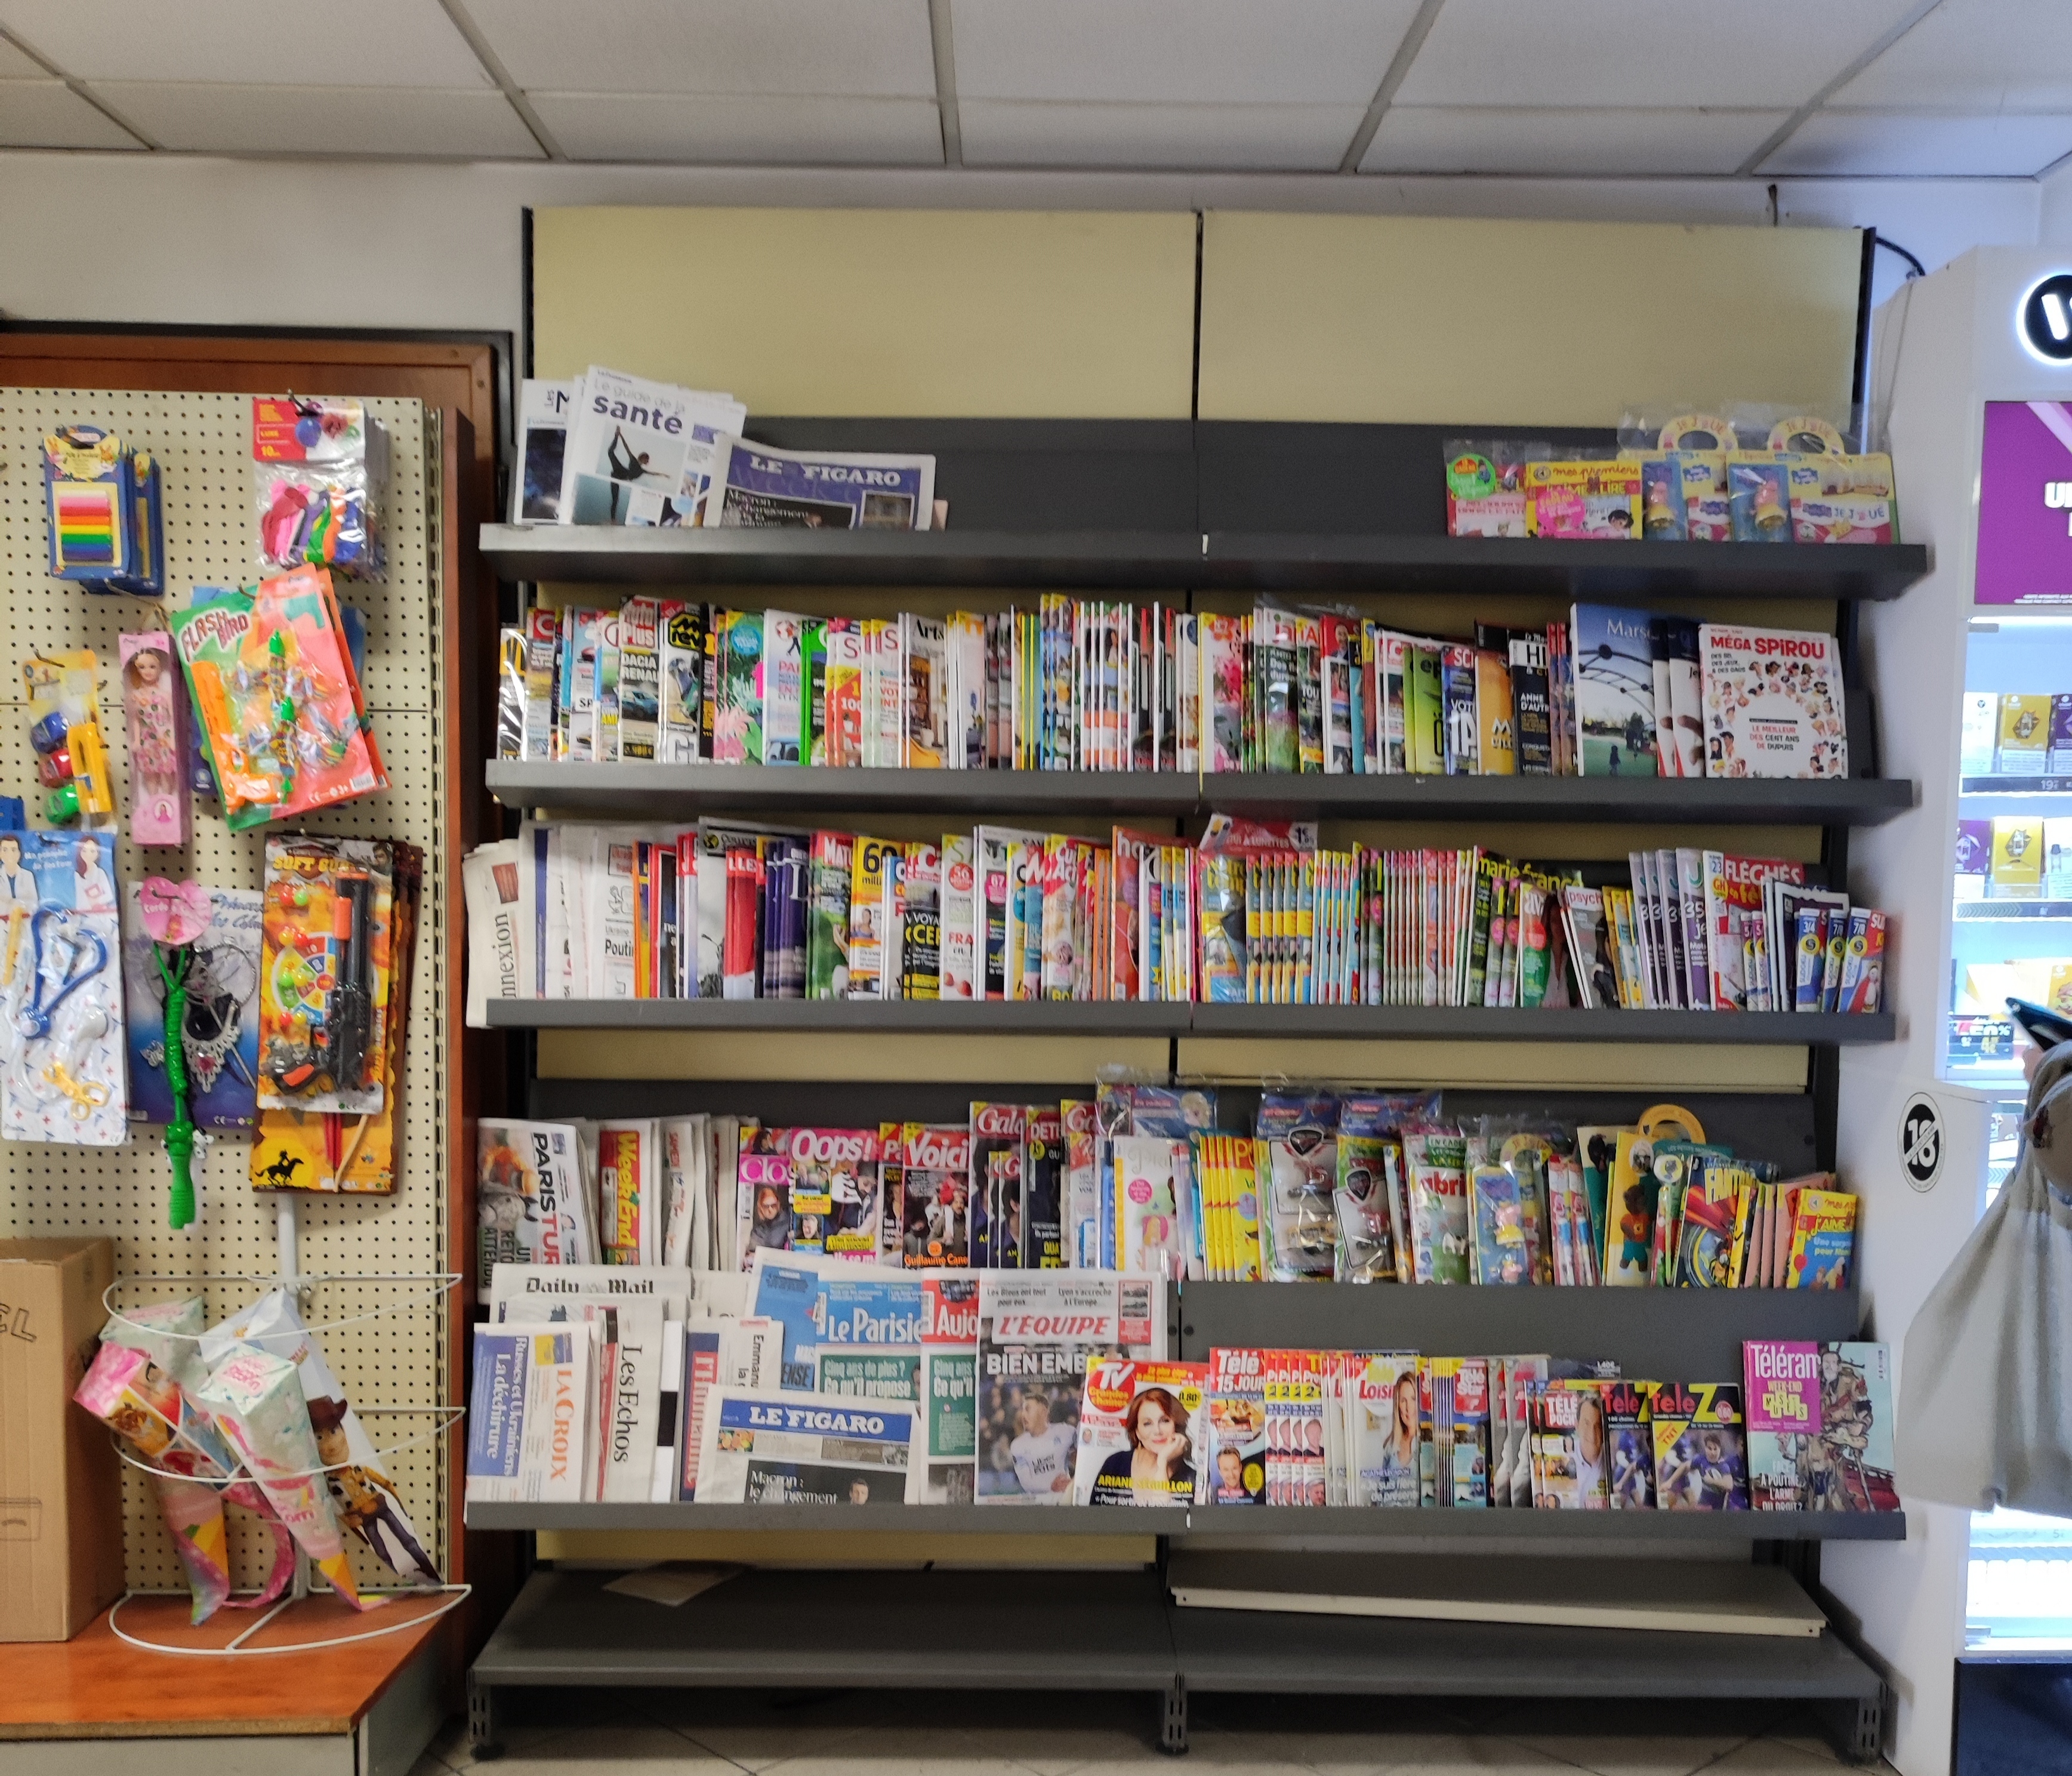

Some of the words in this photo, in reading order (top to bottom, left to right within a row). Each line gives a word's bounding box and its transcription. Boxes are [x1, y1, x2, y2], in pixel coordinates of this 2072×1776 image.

[592, 394, 683, 434] santé
[750, 454, 784, 475] LE
[800, 464, 902, 487] FIGARO
[1710, 634, 1752, 651] MÉGA
[791, 1129, 872, 1168] Oops!
[907, 1132, 969, 1168] Voici
[608, 1278, 655, 1293] Mail
[828, 1314, 850, 1343] Le
[998, 1314, 1112, 1336] L'ÉQUIPE
[619, 1343, 643, 1386] Les
[986, 1352, 1038, 1376] BIEN
[1096, 1362, 1135, 1390] TV
[1217, 1350, 1259, 1375] Télé
[555, 1369, 574, 1396] LA
[1217, 1374, 1234, 1393] 15
[613, 1389, 640, 1463] Echos
[750, 1405, 783, 1426] LE
[785, 1407, 885, 1435] FIGARO
[549, 1397, 575, 1482] CROIX
